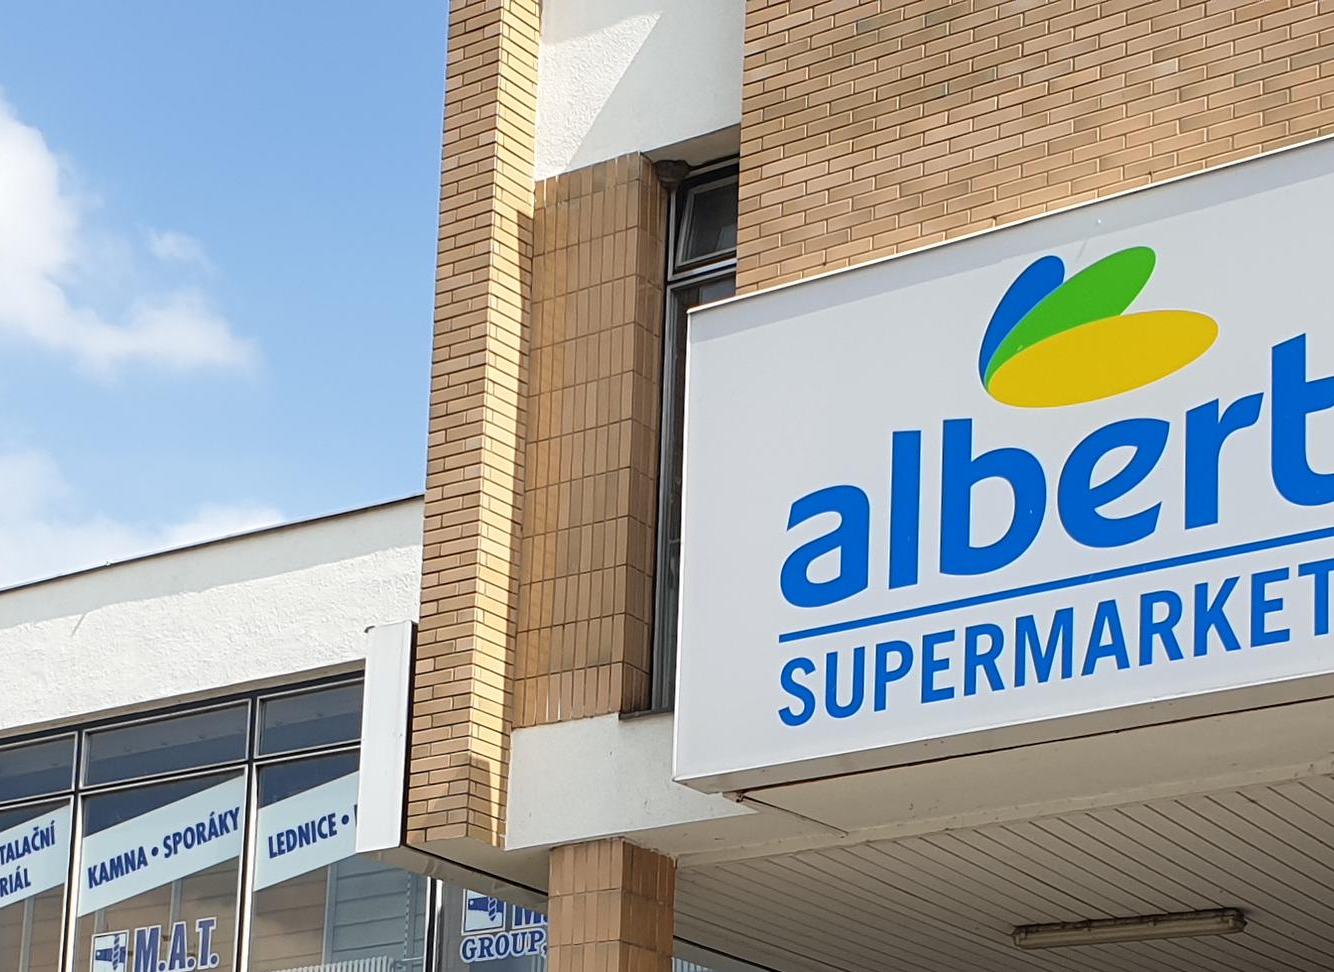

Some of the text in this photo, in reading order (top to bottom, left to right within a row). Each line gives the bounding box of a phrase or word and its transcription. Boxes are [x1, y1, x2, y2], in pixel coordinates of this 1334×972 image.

[87, 806, 241, 889] KAMNA SPORÁKY
[268, 812, 338, 859] LEDNICE
